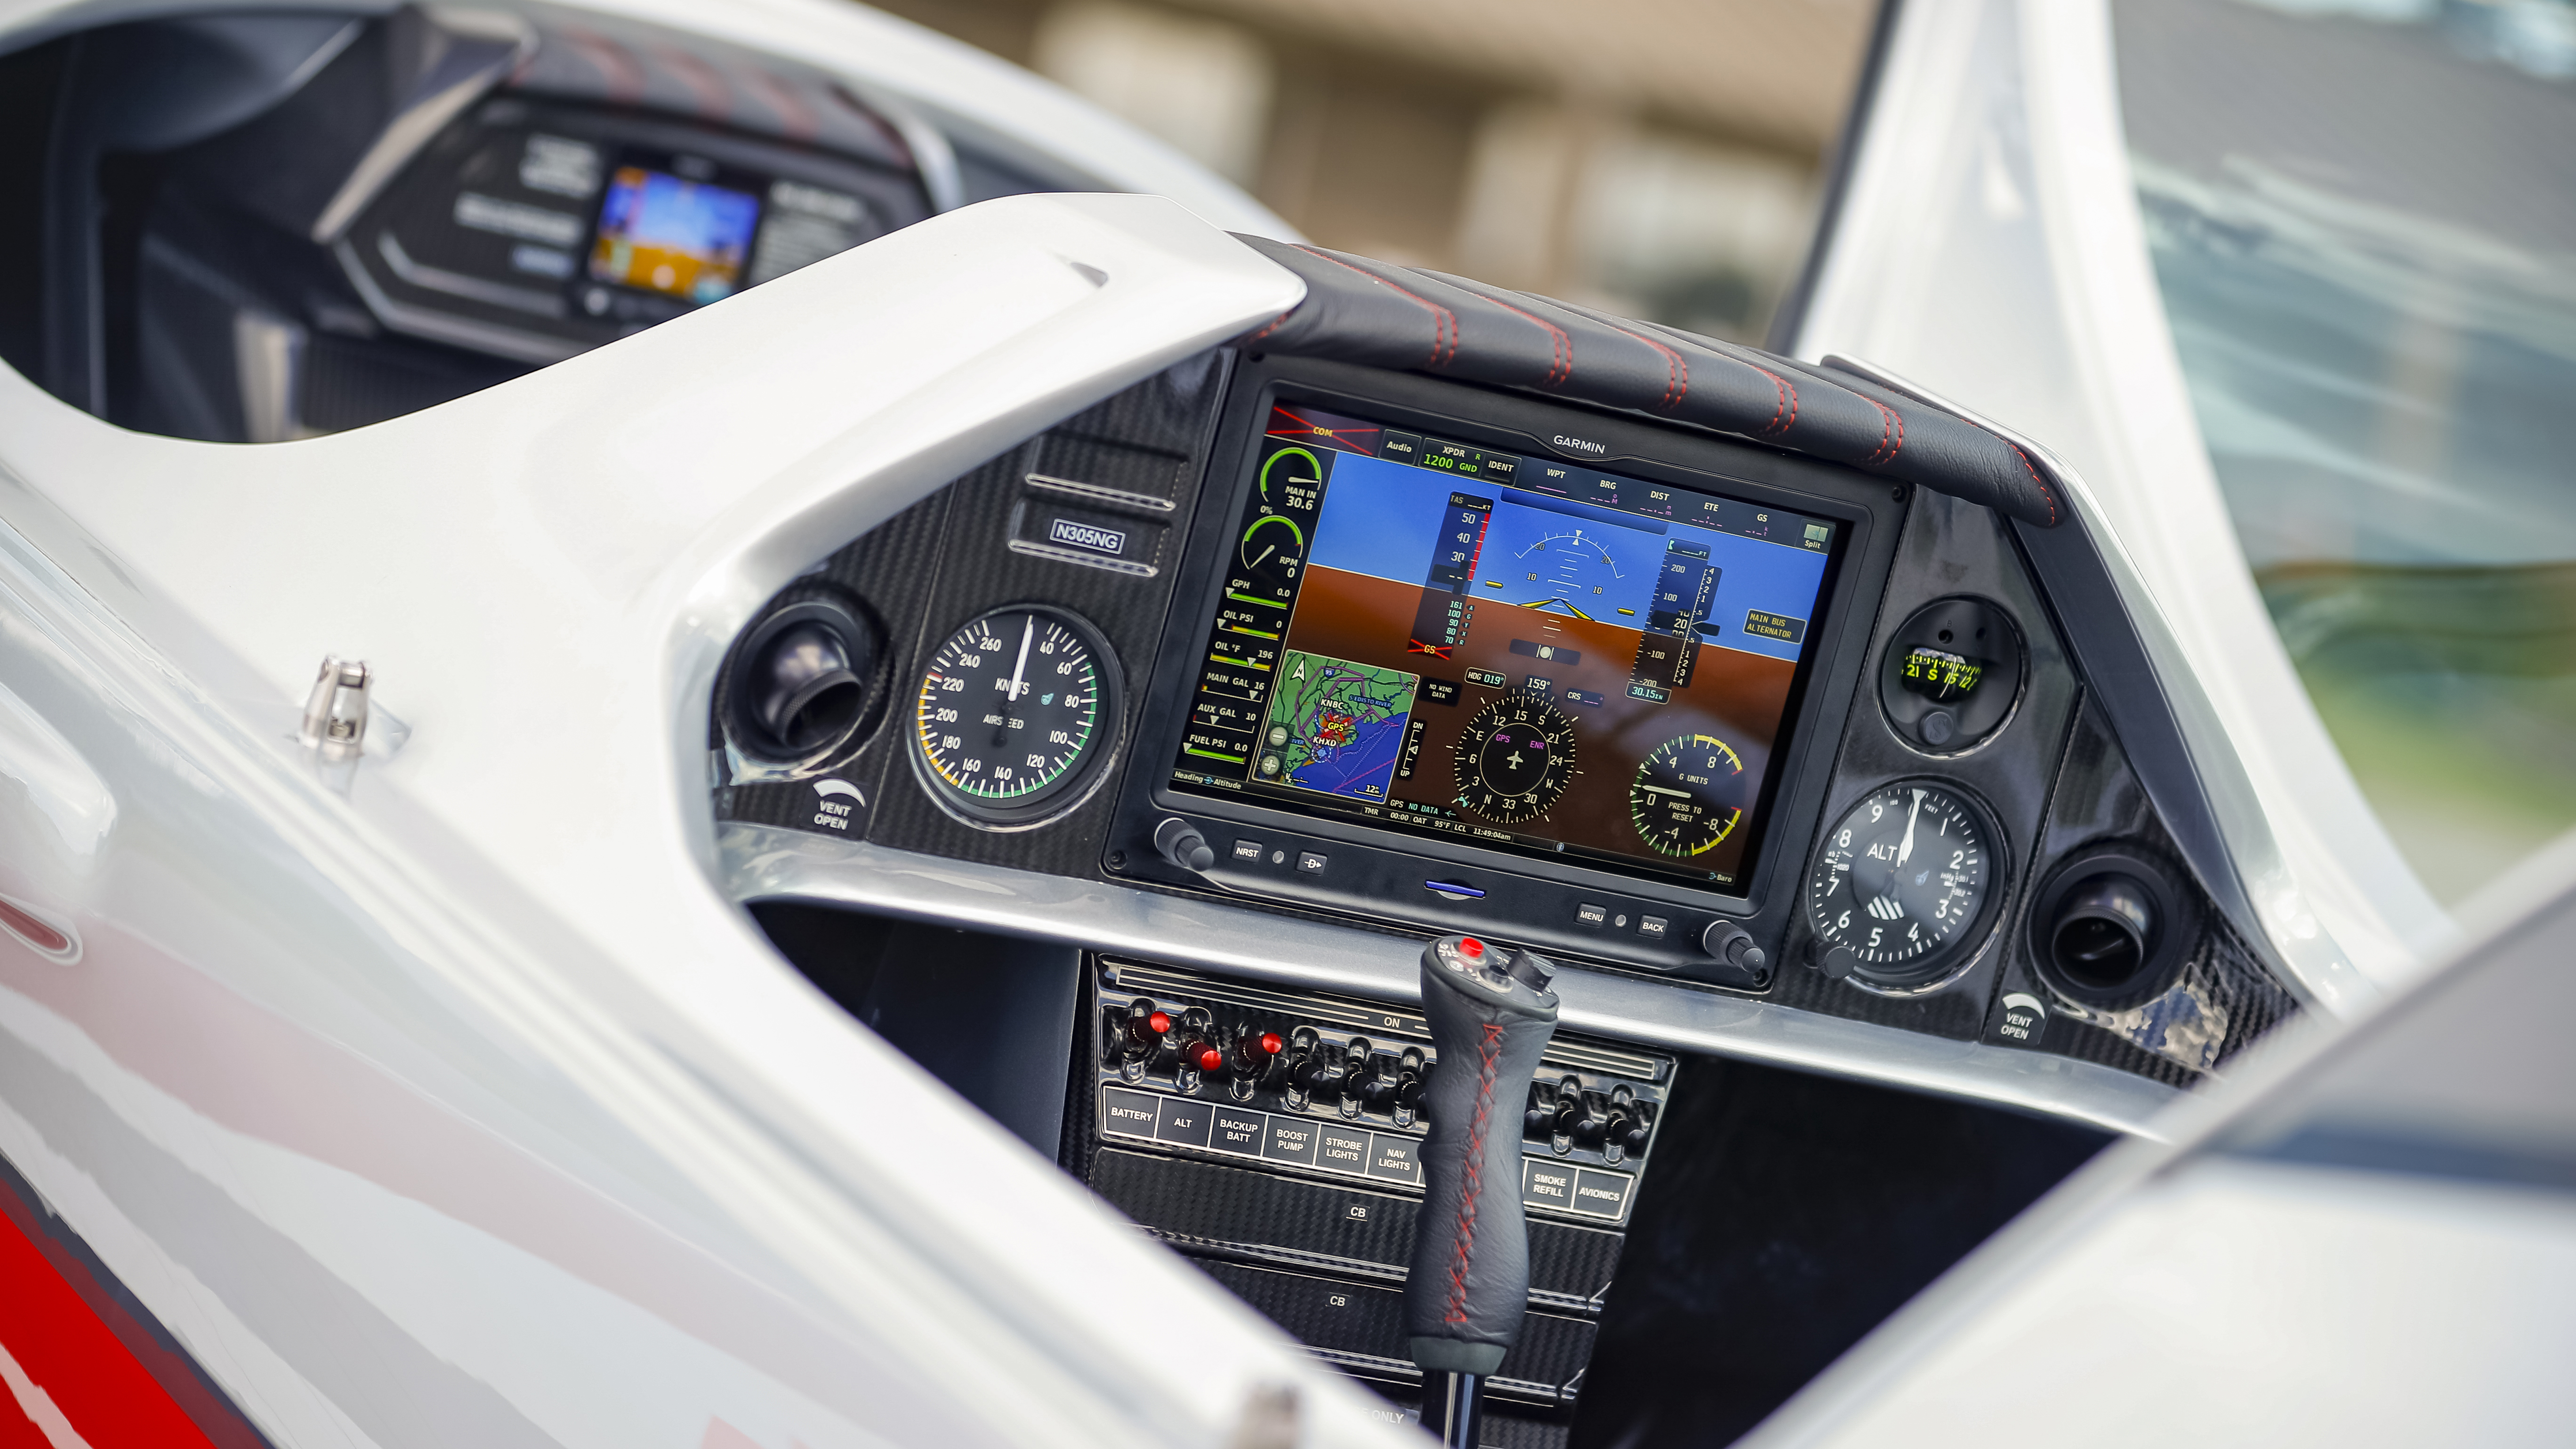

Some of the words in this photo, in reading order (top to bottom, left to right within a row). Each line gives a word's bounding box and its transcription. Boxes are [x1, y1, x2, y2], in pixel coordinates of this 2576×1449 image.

[1313, 427, 1333, 437] COM
[1387, 441, 1411, 453] Audio
[1554, 435, 1605, 454] GARMIN
[1442, 446, 1465, 458] XPDR
[1424, 454, 1453, 469] 1200
[1459, 462, 1477, 473] GND
[1489, 460, 1514, 472] IDENT
[1547, 468, 1566, 479] WPT
[1600, 480, 1617, 490] BRG
[1285, 485, 1305, 497] MAN
[1307, 490, 1317, 499] IN
[1650, 491, 1670, 501] DIST
[1286, 496, 1313, 510] 30.6
[1450, 495, 1464, 504] TAS
[1260, 505, 1272, 515] 0%
[1704, 502, 1719, 512] ETE
[1462, 512, 1476, 524] 50
[1757, 514, 1768, 523] GS
[1056, 523, 1119, 549] N305NG
[1457, 532, 1471, 544] 40
[1804, 540, 1821, 549] Split
[1279, 556, 1298, 566] RPM
[1451, 552, 1465, 562] 30
[1287, 567, 1295, 578] 0
[1232, 579, 1250, 589] GPH
[1277, 588, 1290, 597] 0.0
[1450, 600, 1463, 610] 161
[1224, 610, 1237, 620] OIL
[1240, 613, 1254, 623] PSI
[1448, 609, 1461, 618] 100
[1449, 619, 1458, 627] 90
[1750, 613, 1769, 623] MAIN
[1772, 618, 1786, 627] BUS
[1446, 627, 1456, 636] 80
[1747, 623, 1792, 638] ALTERNATOR
[979, 637, 1002, 652] 260
[1215, 641, 1229, 651] OIL
[1445, 636, 1454, 644] 70
[1039, 641, 1055, 655] 40
[1424, 644, 1436, 654] GS
[959, 653, 981, 668] 240
[1258, 650, 1273, 659] 196
[1057, 662, 1072, 676] 60
[1907, 664, 1919, 677] 21
[1927, 668, 1938, 681] S
[1944, 672, 1959, 684] 15
[942, 676, 965, 692] 220
[1206, 672, 1229, 683] MAIN
[1232, 677, 1249, 688] GAL
[1254, 682, 1265, 690] 16
[1468, 671, 1482, 680] HDG
[1484, 674, 1504, 685] 019°
[1527, 677, 1551, 691] 159°
[995, 677, 1030, 695] KNTS
[1064, 694, 1079, 708] 80
[1432, 691, 1445, 699] DATA
[1568, 692, 1581, 700] CRS
[1320, 699, 1344, 710] KNBC
[935, 708, 958, 723] 200
[1197, 703, 1216, 713] AUX
[1219, 708, 1236, 718] GAL
[1246, 712, 1256, 721] 10
[1514, 710, 1528, 721] 15
[983, 714, 1024, 729] AIRSEED
[1493, 715, 1506, 726] 12
[1538, 715, 1546, 725] S
[1328, 722, 1344, 732] GPS
[1049, 730, 1068, 745] 100
[1312, 736, 1337, 747] KHXD
[1476, 731, 1484, 741] E
[1496, 734, 1511, 743] GPS
[1547, 733, 1560, 744] 21
[942, 735, 961, 750] 180
[1189, 734, 1210, 745] FUEL
[1212, 739, 1226, 748] PSI
[1234, 743, 1248, 752] 0.0
[1530, 741, 1544, 750] ENR
[962, 757, 981, 773] 160
[1027, 754, 1045, 768] 120
[1469, 754, 1477, 764] 6
[1550, 756, 1563, 766] 24
[1669, 757, 1677, 768] 4
[1707, 756, 1717, 768] 8
[994, 765, 1013, 781] 140
[1175, 771, 1203, 783] Heading
[1214, 778, 1241, 789] Altitude
[1472, 776, 1480, 786] 3
[1546, 778, 1554, 789] W
[1687, 774, 1708, 785] UNITS
[1484, 794, 1492, 805] N
[1502, 798, 1516, 809] 33
[1524, 793, 1538, 804] 30
[820, 800, 852, 817] VENT
[1390, 799, 1404, 808] GPS
[1421, 805, 1438, 814] DATA
[1668, 802, 1690, 812] PRESS
[1364, 807, 1379, 815] TMR
[1390, 812, 1409, 821] 00:00
[1672, 813, 1693, 823] RESET
[1871, 805, 1883, 824] 9
[813, 813, 848, 830] OPEN
[1413, 816, 1427, 824] OAT
[1434, 820, 1451, 829] 95°F
[1454, 824, 1466, 832] LCL
[1473, 828, 1511, 841] 11:49:04am
[1839, 829, 1852, 848] 8
[1236, 847, 1259, 858] NRST
[1867, 843, 1898, 861] ALT
[1950, 850, 1964, 870] 2
[1717, 874, 1732, 883] Baro
[1827, 877, 1840, 897] 7
[1936, 899, 1950, 919] 3
[1580, 911, 1604, 922] MENU
[1838, 910, 1851, 929] 6
[1642, 922, 1664, 933] BACK
[1908, 922, 1919, 942] 4
[1868, 927, 1883, 948] 5
[1383, 1017, 1401, 1029] ON
[2007, 1013, 2033, 1028] VENT
[2001, 1023, 2029, 1040] OPEN
[1111, 1107, 1154, 1123] BATTERY
[1174, 1118, 1192, 1128] ALT
[1219, 1119, 1258, 1133] BACKUP
[1226, 1130, 1251, 1143] BATT
[1276, 1129, 1309, 1142] BOOST
[1277, 1140, 1304, 1152] PUMP
[1325, 1137, 1362, 1151] STROBE
[1326, 1149, 1359, 1161] LIGHTS
[1386, 1148, 1407, 1159] NAV
[1378, 1158, 1410, 1171] LIGHTS
[1534, 1174, 1566, 1187] SMOKE
[1533, 1184, 1563, 1198] REFILL
[1578, 1186, 1620, 1201] AVIONICS
[1350, 1207, 1366, 1218] CB
[1329, 1296, 1346, 1307] CB
[1372, 1410, 1404, 1424] ONLY
